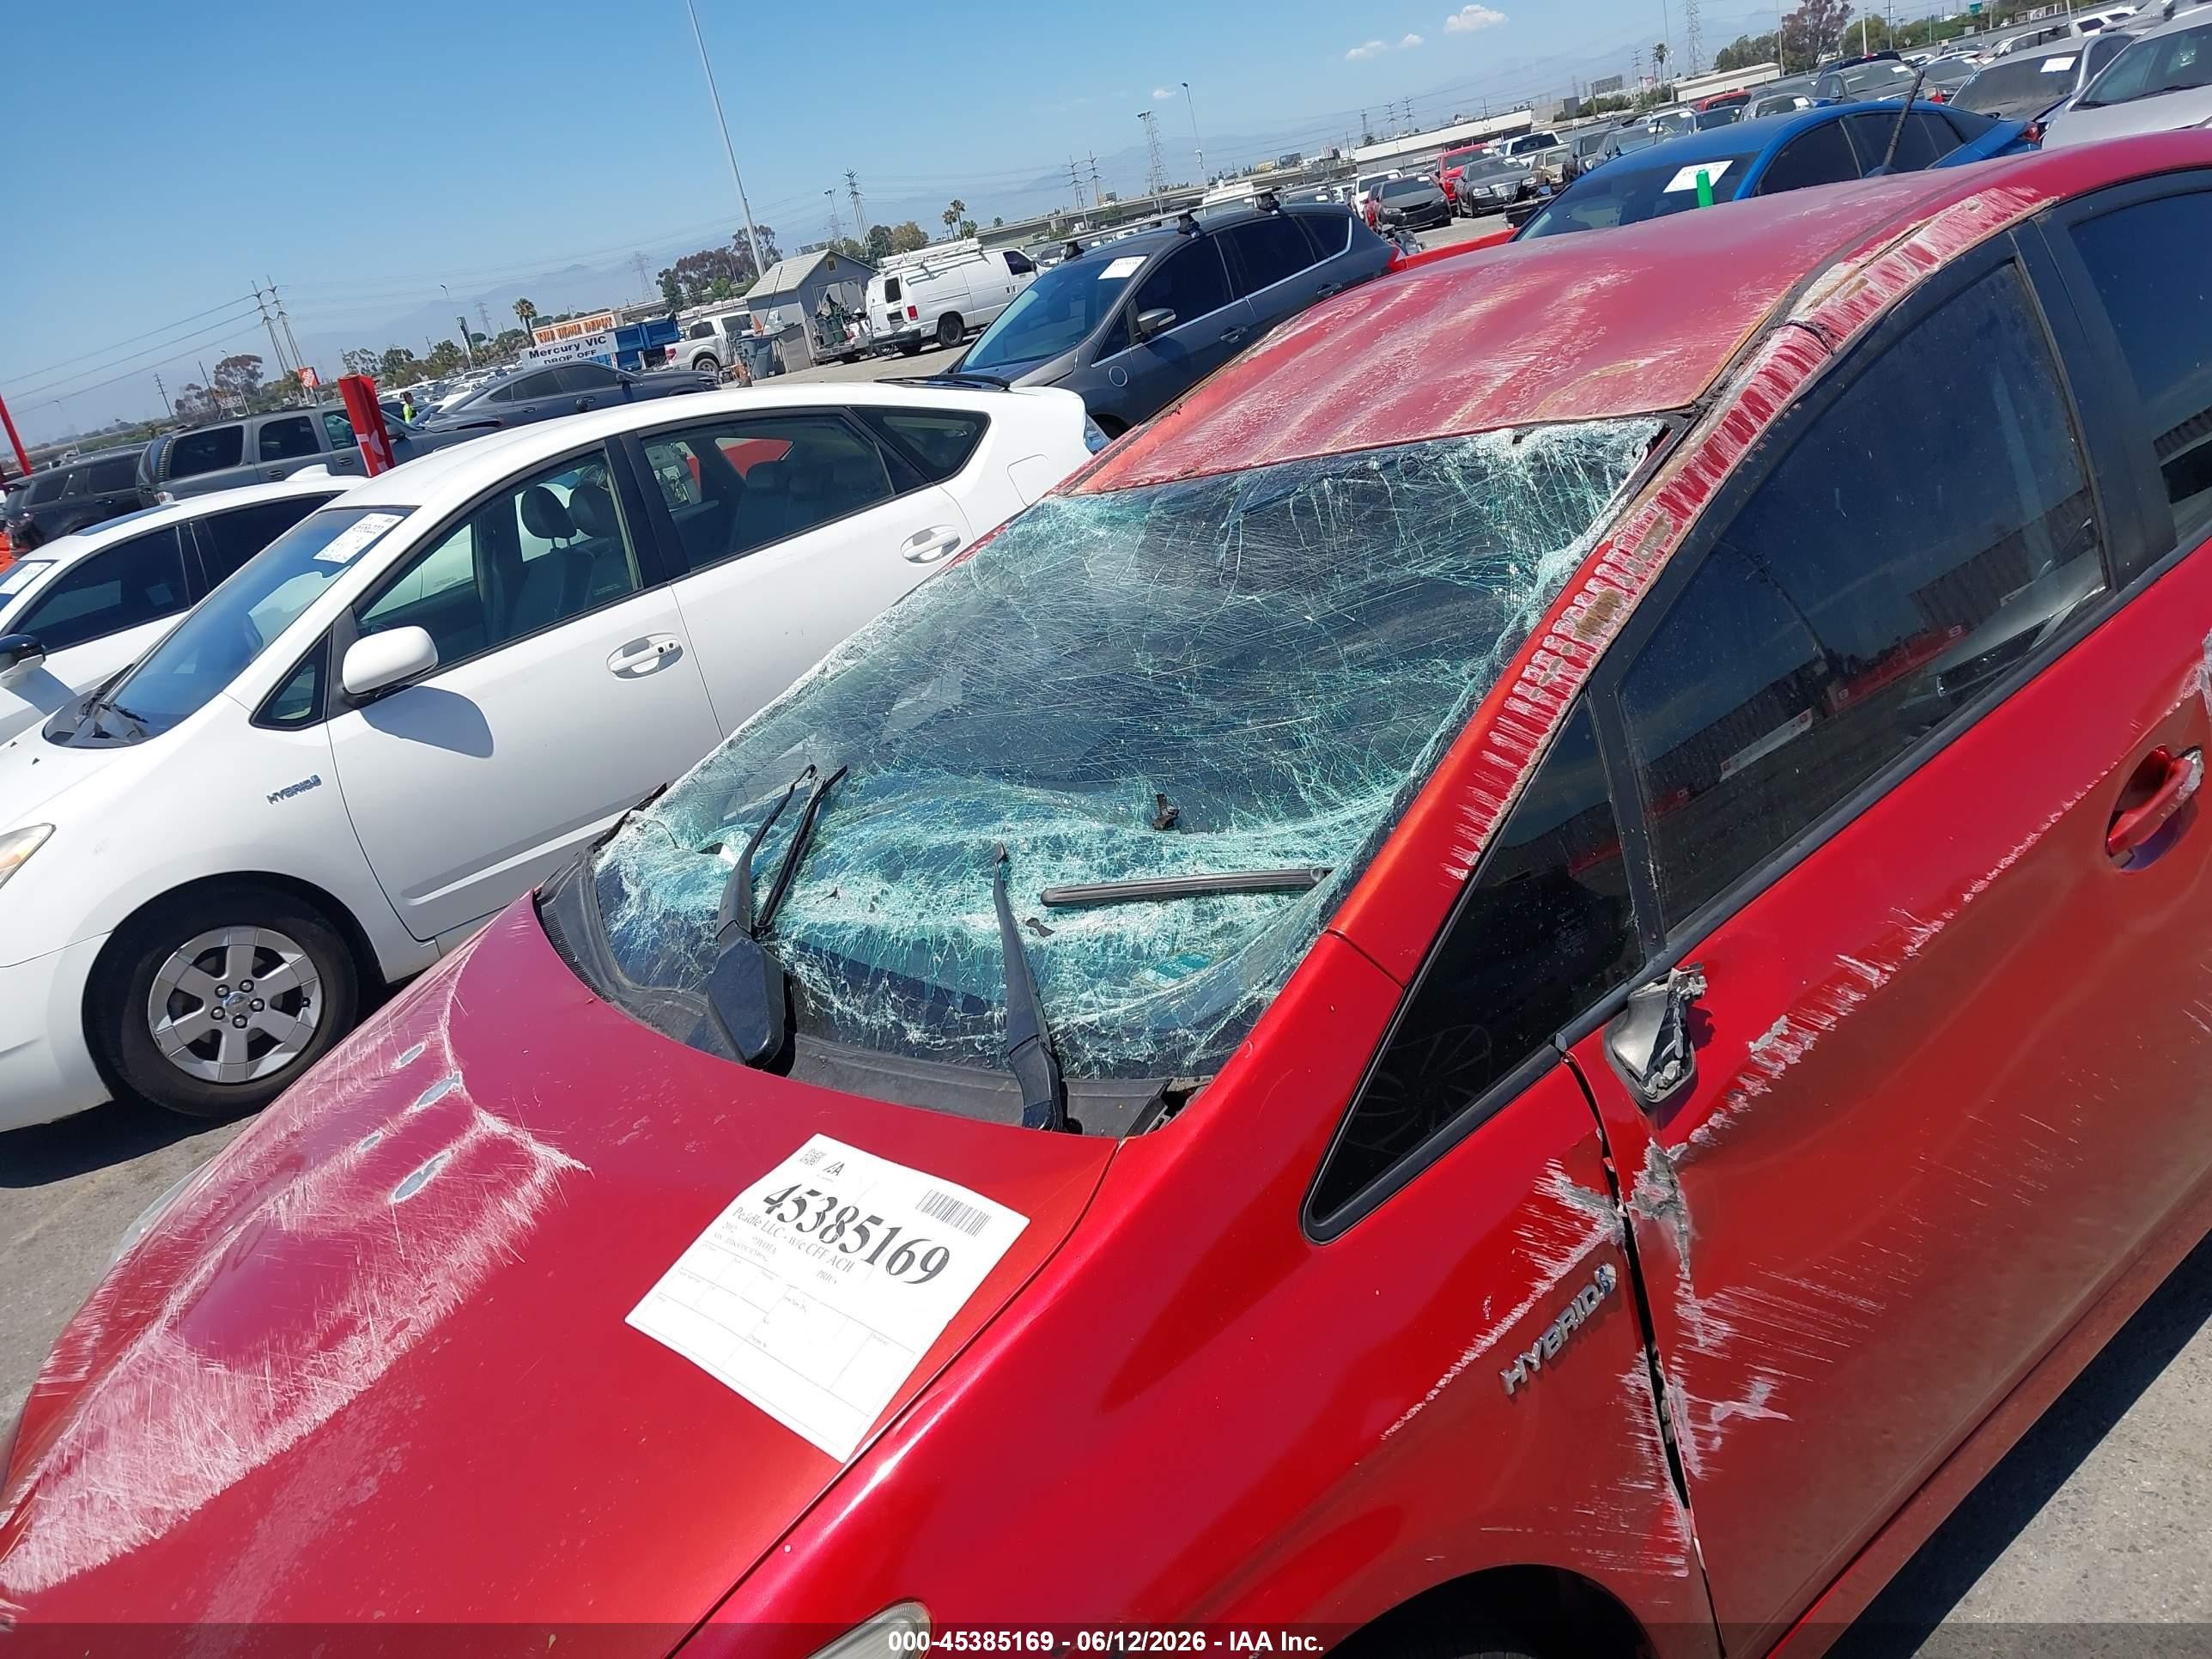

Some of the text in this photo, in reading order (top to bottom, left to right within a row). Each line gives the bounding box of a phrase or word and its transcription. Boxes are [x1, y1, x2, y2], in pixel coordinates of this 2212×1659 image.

[584, 316, 612, 333] DEPOT
[528, 336, 606, 359] Mercury VIC
[544, 349, 598, 365] DROP OFF
[265, 779, 314, 805] HYBRID
[761, 1221, 786, 1240] LLC
[763, 1183, 951, 1285] 45385169
[1499, 1283, 1603, 1395] HYBRID
